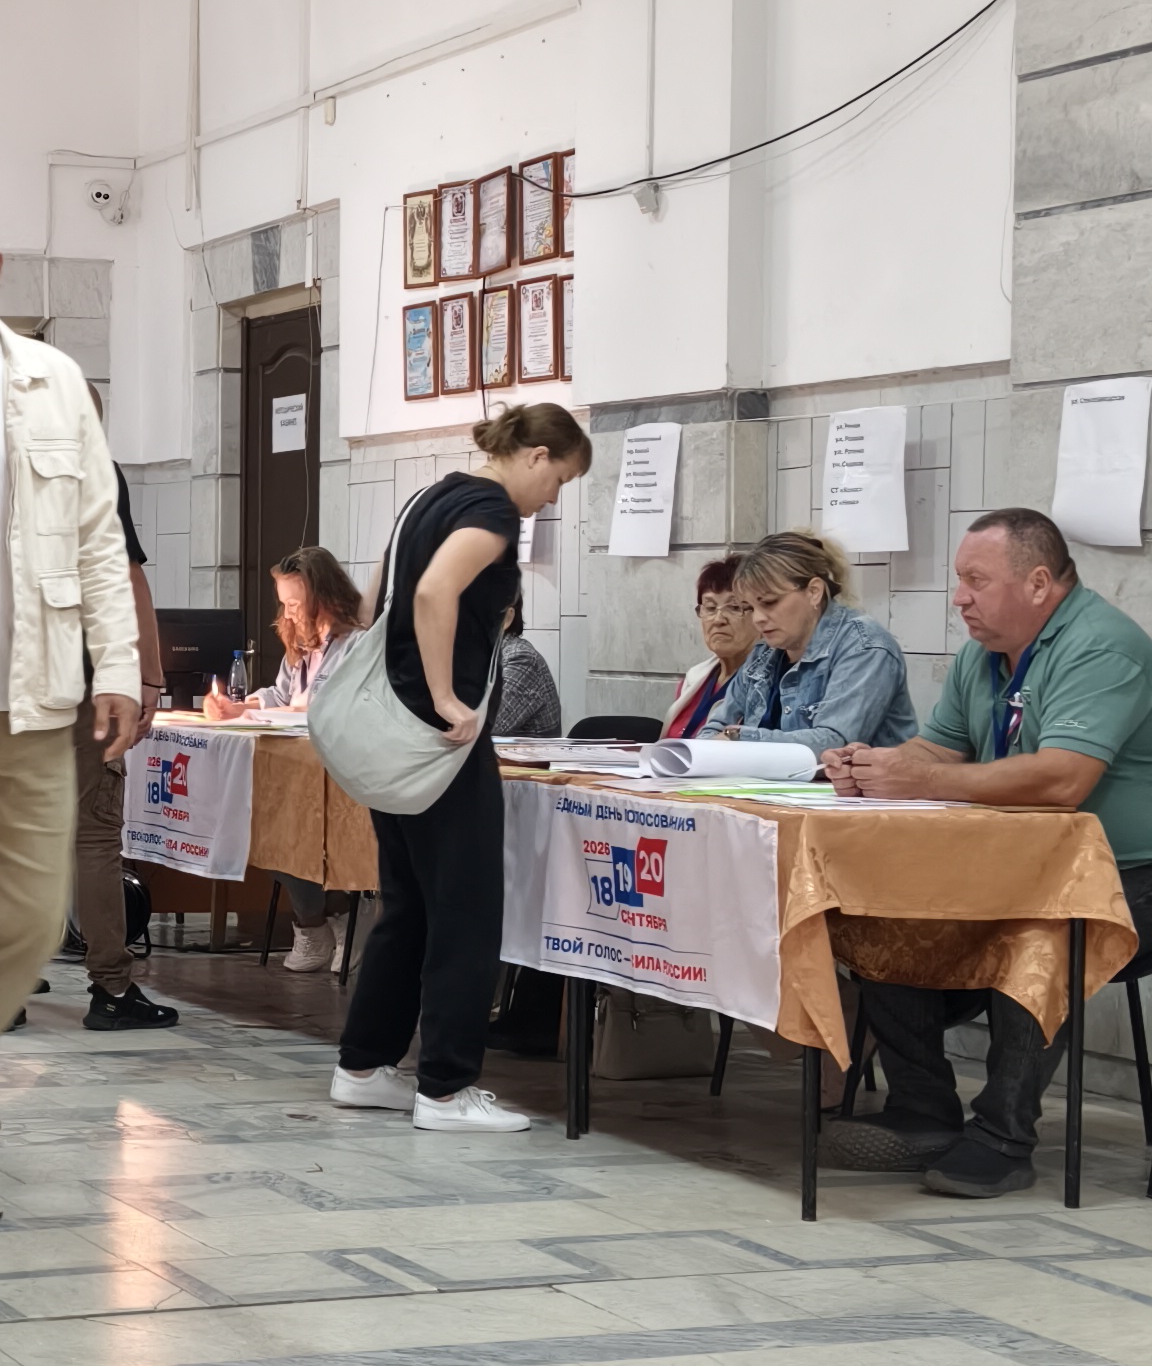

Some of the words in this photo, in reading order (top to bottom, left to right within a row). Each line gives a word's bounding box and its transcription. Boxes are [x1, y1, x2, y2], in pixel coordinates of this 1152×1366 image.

[148, 781, 160, 804] 18
[583, 840, 611, 855] 2026
[616, 861, 633, 893] 19
[639, 850, 663, 883] 20
[591, 875, 614, 906] 18
[620, 909, 668, 932] СНТЯБРЯ
[544, 935, 583, 955] ТВОЙ
[587, 942, 623, 963] ГОЛОС
[631, 954, 661, 973] ИЛА
